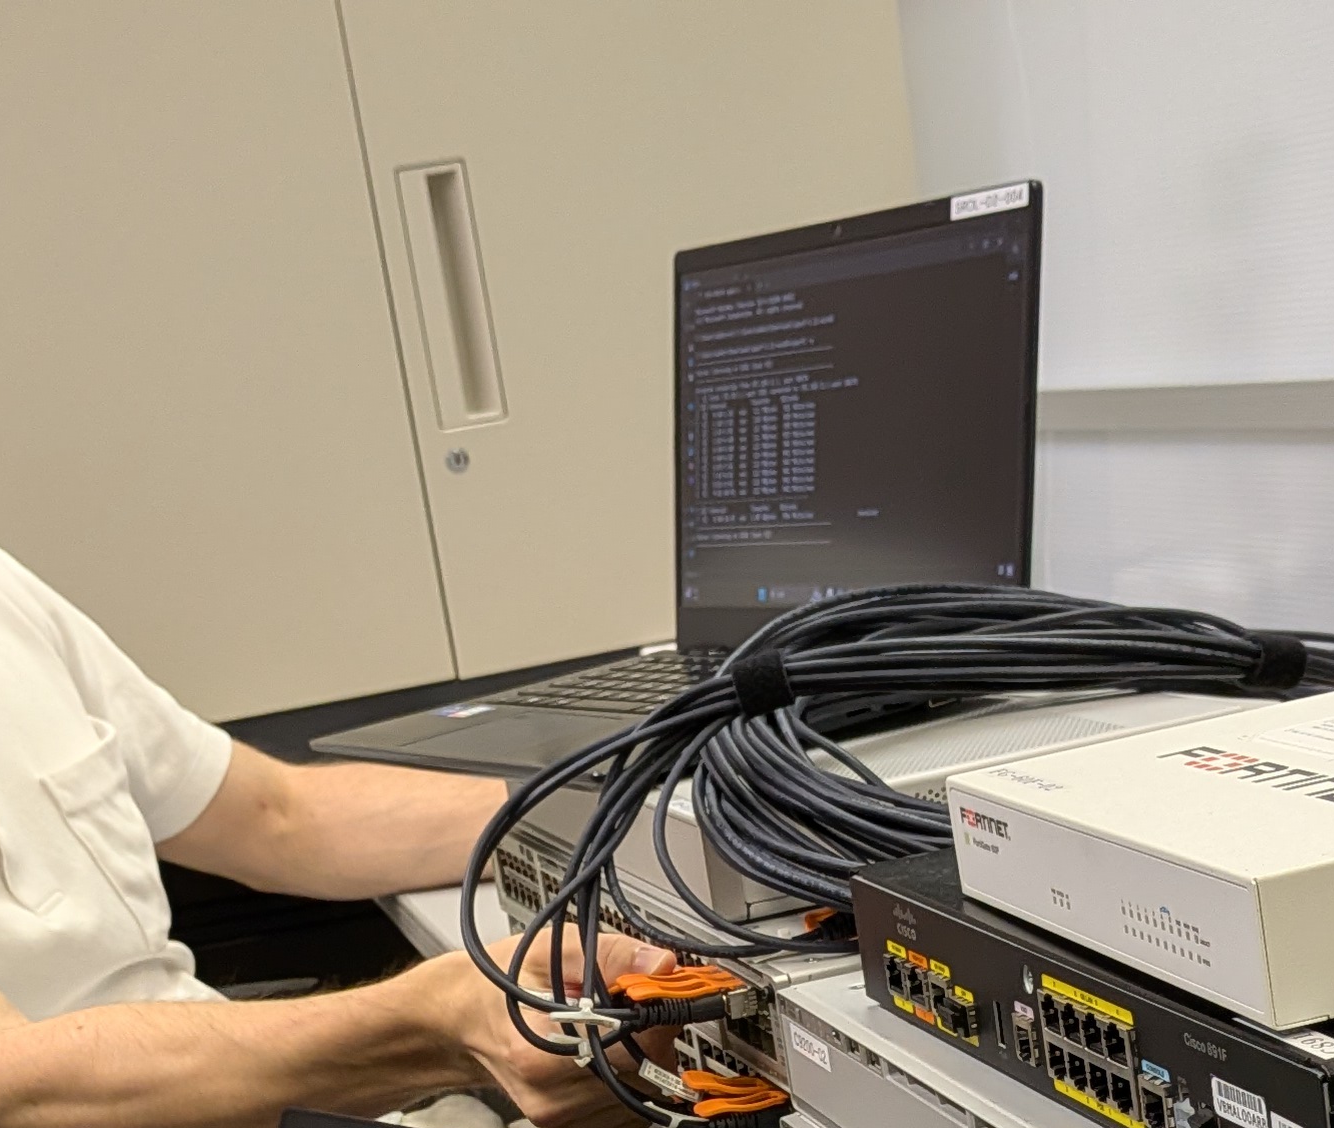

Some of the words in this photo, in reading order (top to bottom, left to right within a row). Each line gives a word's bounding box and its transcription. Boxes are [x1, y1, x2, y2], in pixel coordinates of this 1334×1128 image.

[959, 806, 1009, 840] FORTINET
[793, 1031, 828, 1065] C9200-02
[1183, 1032, 1207, 1054] Cisco
[1206, 1040, 1228, 1062] 891F
